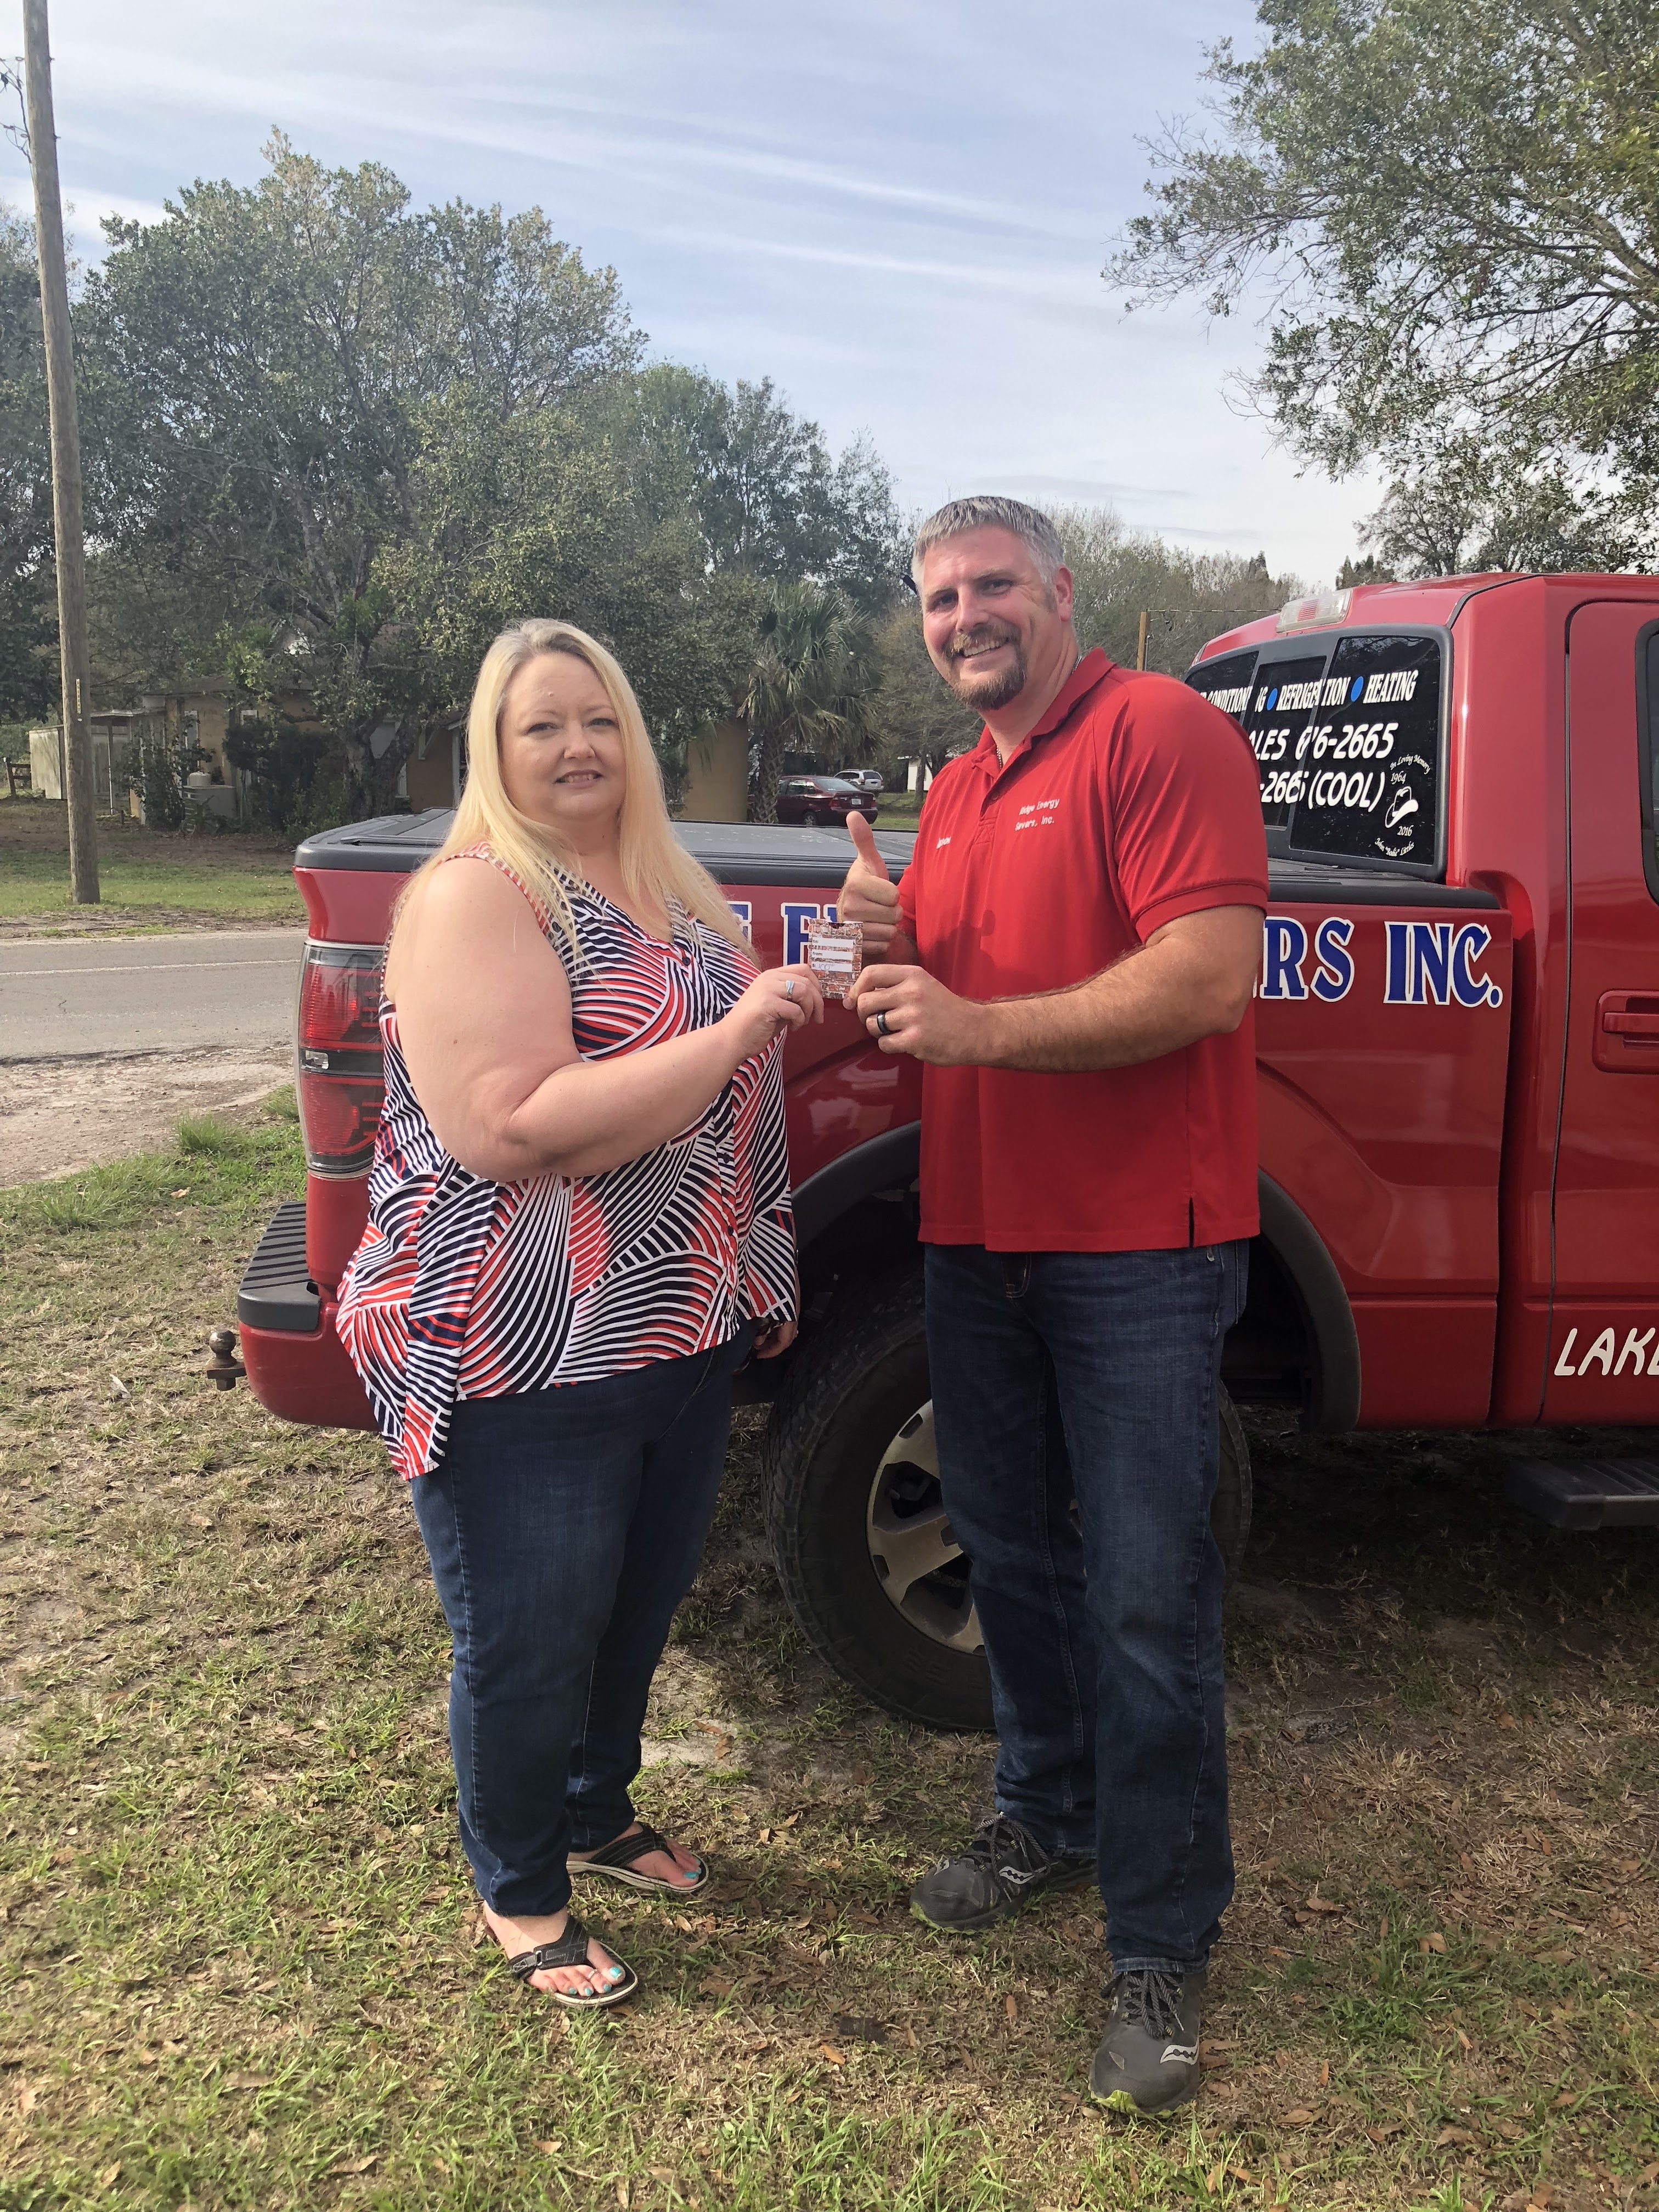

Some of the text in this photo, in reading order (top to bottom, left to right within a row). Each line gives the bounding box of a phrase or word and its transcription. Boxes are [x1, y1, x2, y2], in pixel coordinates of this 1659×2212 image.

[1363, 669, 1419, 703] HEATING
[1397, 754, 1414, 766] Loving
[1413, 754, 1431, 775] Memory
[1391, 770, 1407, 785] 1964
[1308, 769, 1385, 812] (COOL)
[1036, 799, 1060, 810] Energy
[1041, 816, 1054, 825] Inc.
[1397, 825, 1414, 837] 2016
[1375, 838, 1385, 851] John
[1383, 921, 1503, 1008] INC.
